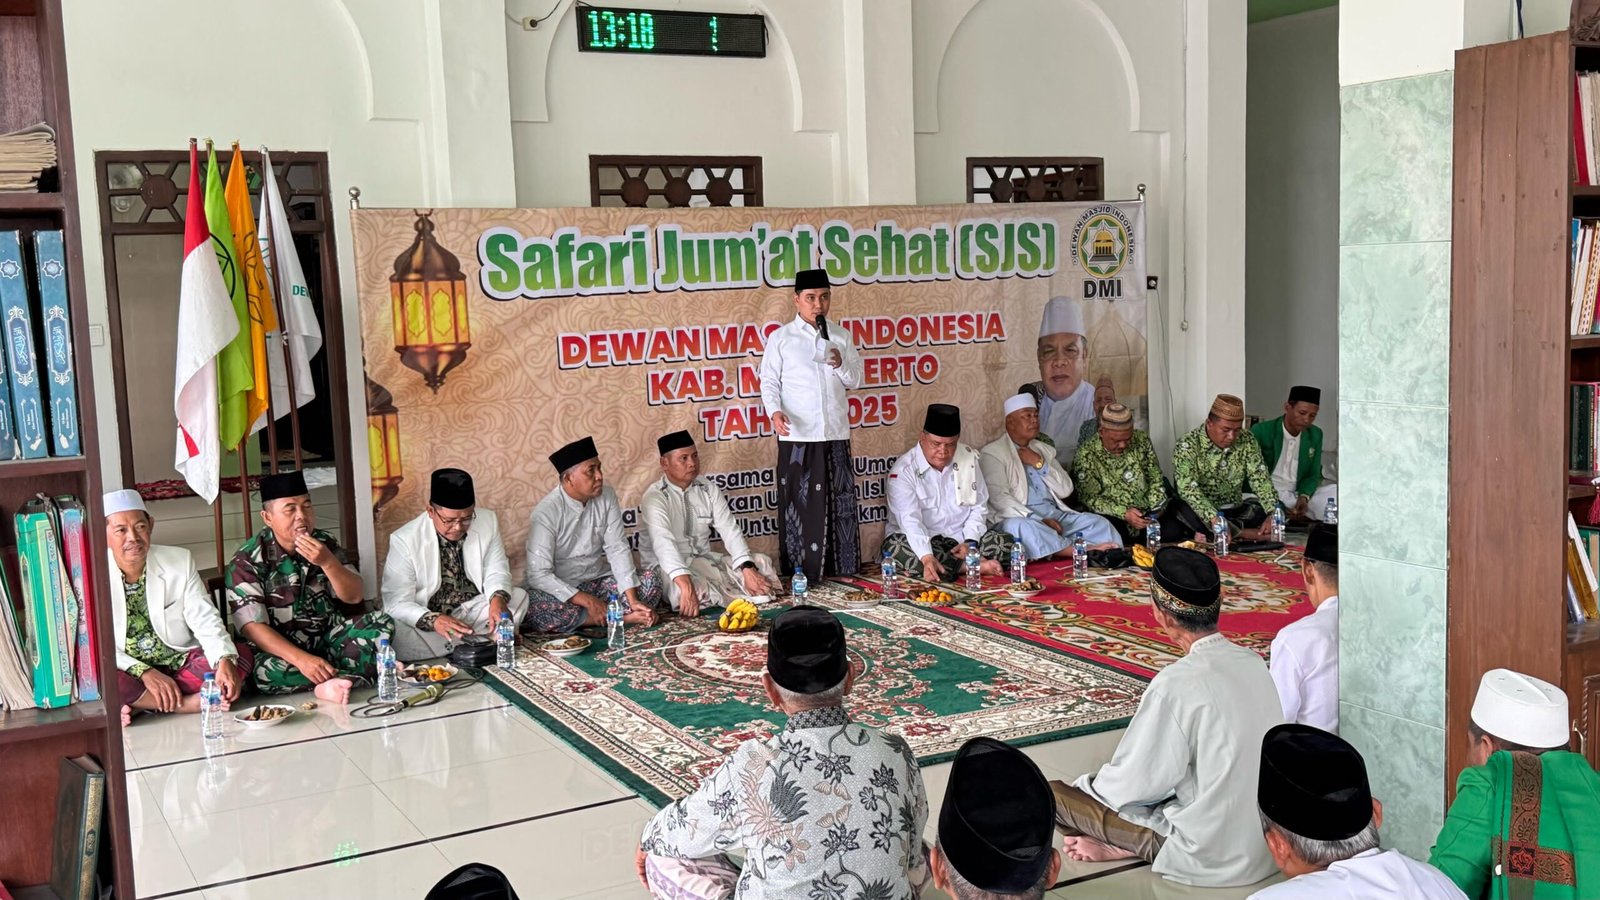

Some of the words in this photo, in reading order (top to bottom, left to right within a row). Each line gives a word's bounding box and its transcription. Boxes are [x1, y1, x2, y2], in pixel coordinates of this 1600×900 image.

[1071, 221, 1084, 256] DEWAN
[1082, 206, 1111, 222] MASJID
[1112, 208, 1134, 254] INDONESIA
[481, 227, 650, 297] Safari
[657, 224, 815, 289] Jum'at
[821, 222, 951, 281] Sehat
[1083, 279, 1122, 299] DMI
[559, 326, 702, 367] DEWAN
[648, 367, 735, 402] KAB.
[701, 406, 773, 438] TAH
[847, 394, 897, 427] 025
